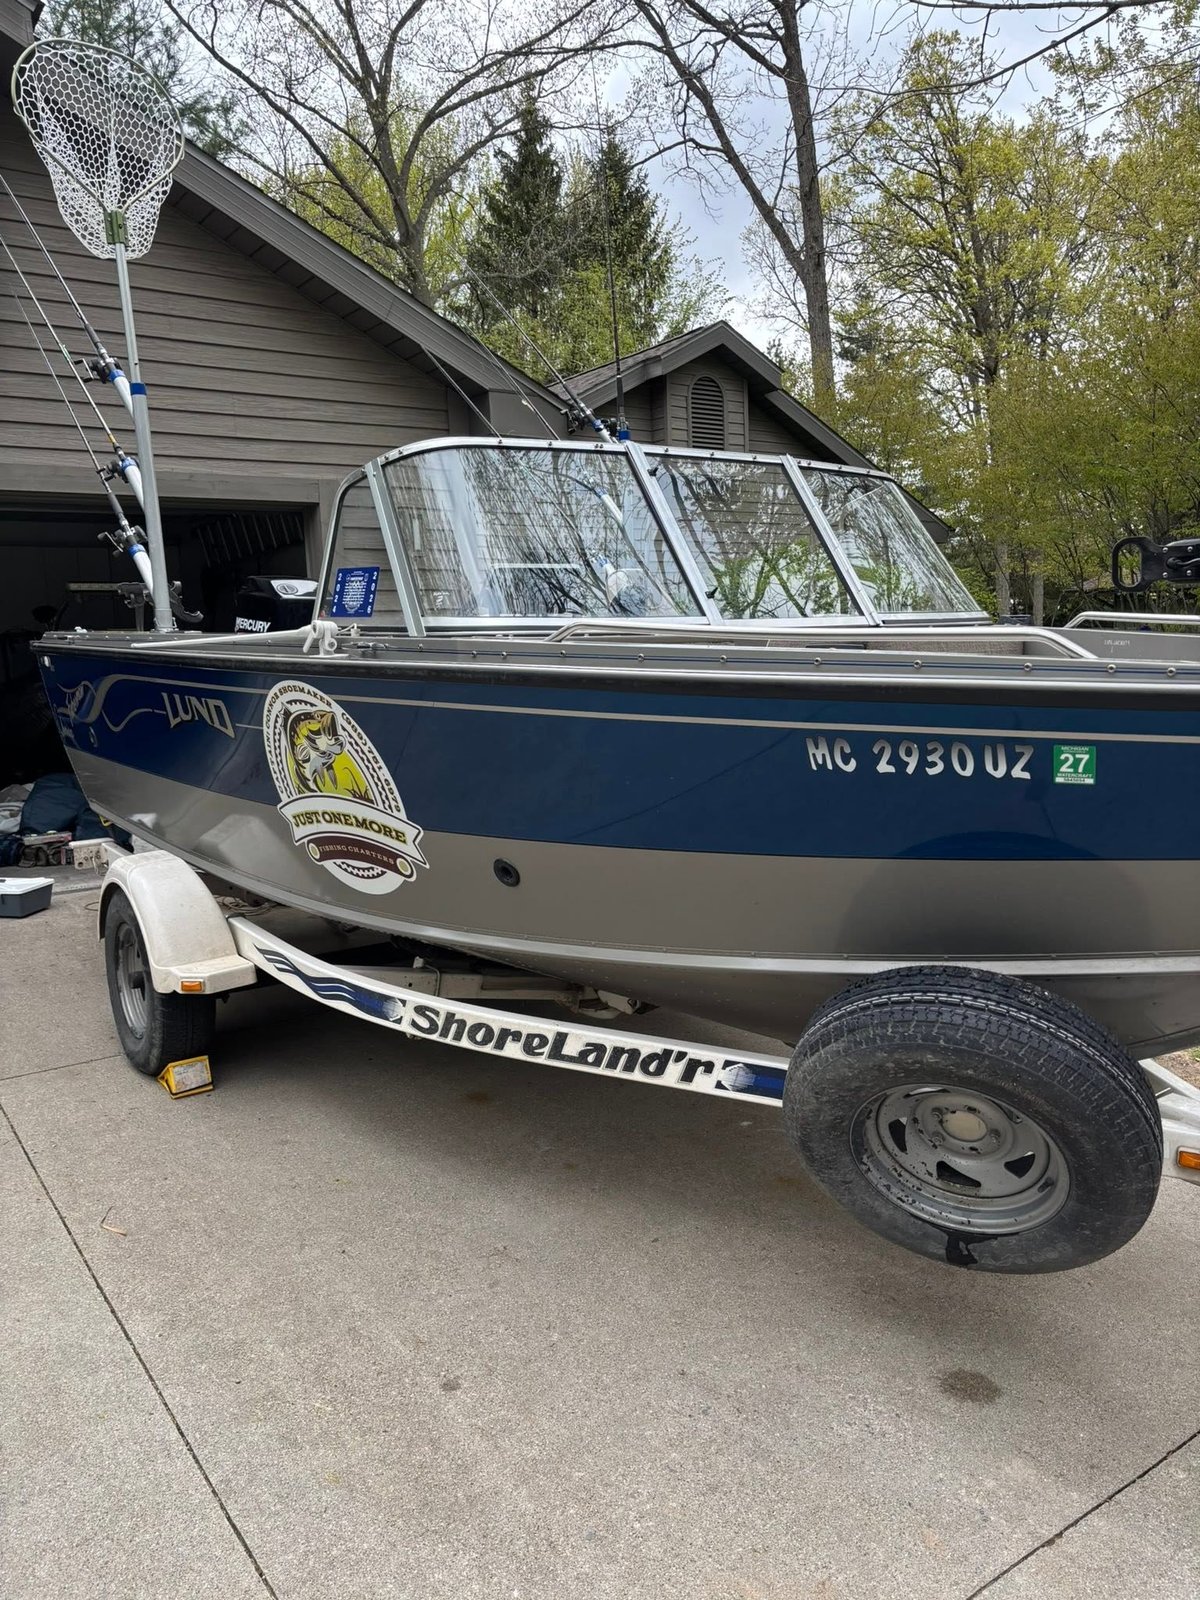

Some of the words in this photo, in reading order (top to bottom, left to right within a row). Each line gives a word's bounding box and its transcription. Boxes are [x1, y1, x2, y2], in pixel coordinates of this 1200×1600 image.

[236, 616, 272, 633] MERCURY
[278, 685, 333, 709] SHOEMAKER
[161, 692, 236, 739] LUND
[341, 712, 368, 746] (989)
[805, 736, 857, 773] MC
[872, 738, 975, 777] 2930
[984, 744, 1035, 780] UZ
[1059, 753, 1090, 773] 27
[292, 811, 321, 828] JUST
[321, 811, 354, 827] ONE
[354, 816, 408, 845] MORE
[318, 844, 348, 853] FISHING
[348, 845, 395, 866] CHARTERS
[409, 1003, 716, 1084] ShoreLand'r
